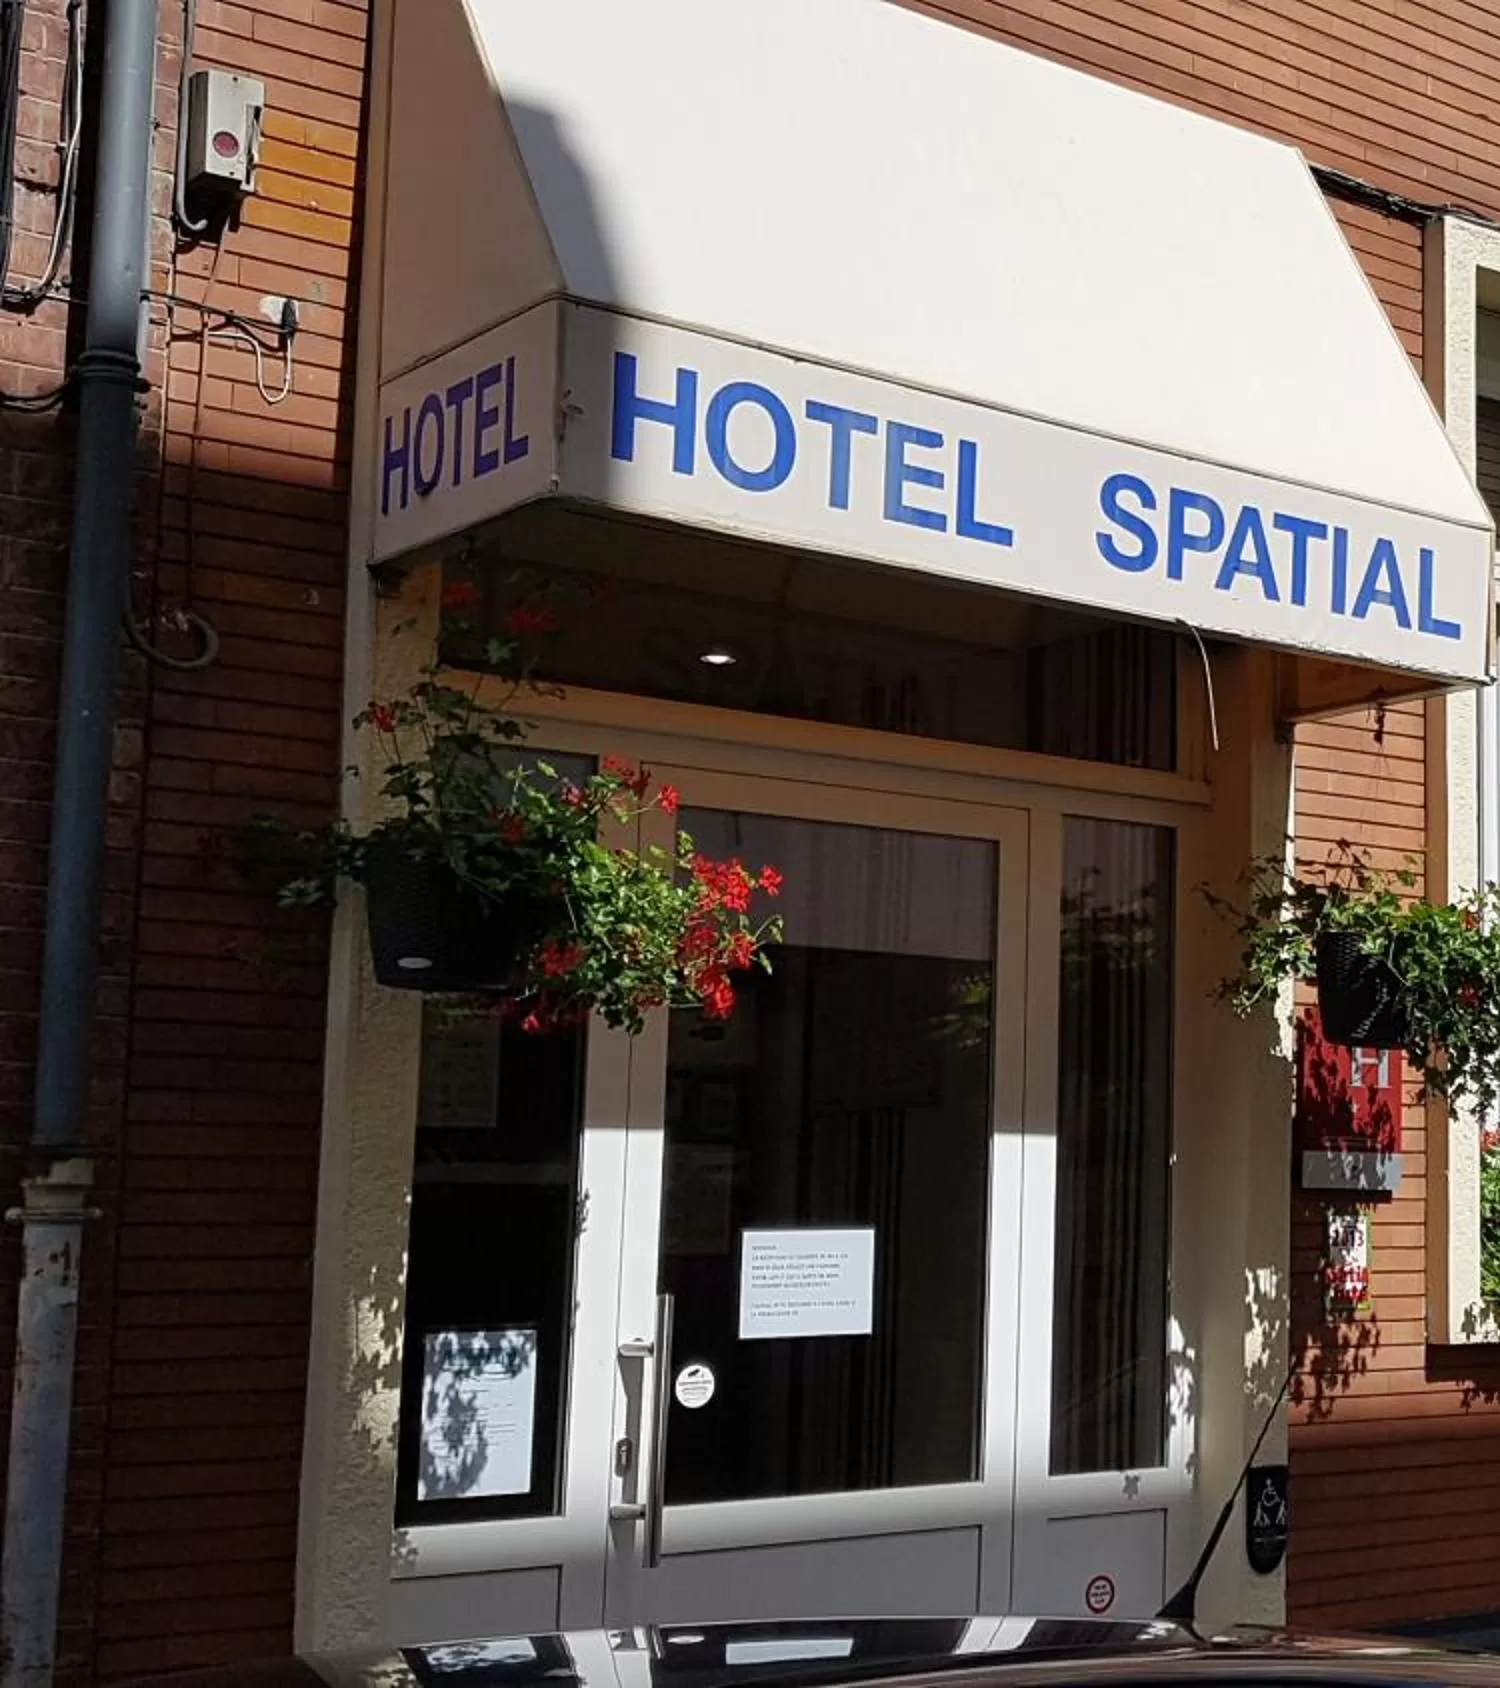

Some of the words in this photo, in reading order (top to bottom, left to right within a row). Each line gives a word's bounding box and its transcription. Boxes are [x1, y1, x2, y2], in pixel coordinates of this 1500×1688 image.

[381, 356, 529, 516] HOTEL
[611, 351, 1013, 548] HOTEL
[1095, 473, 1461, 640] SPATIAL
